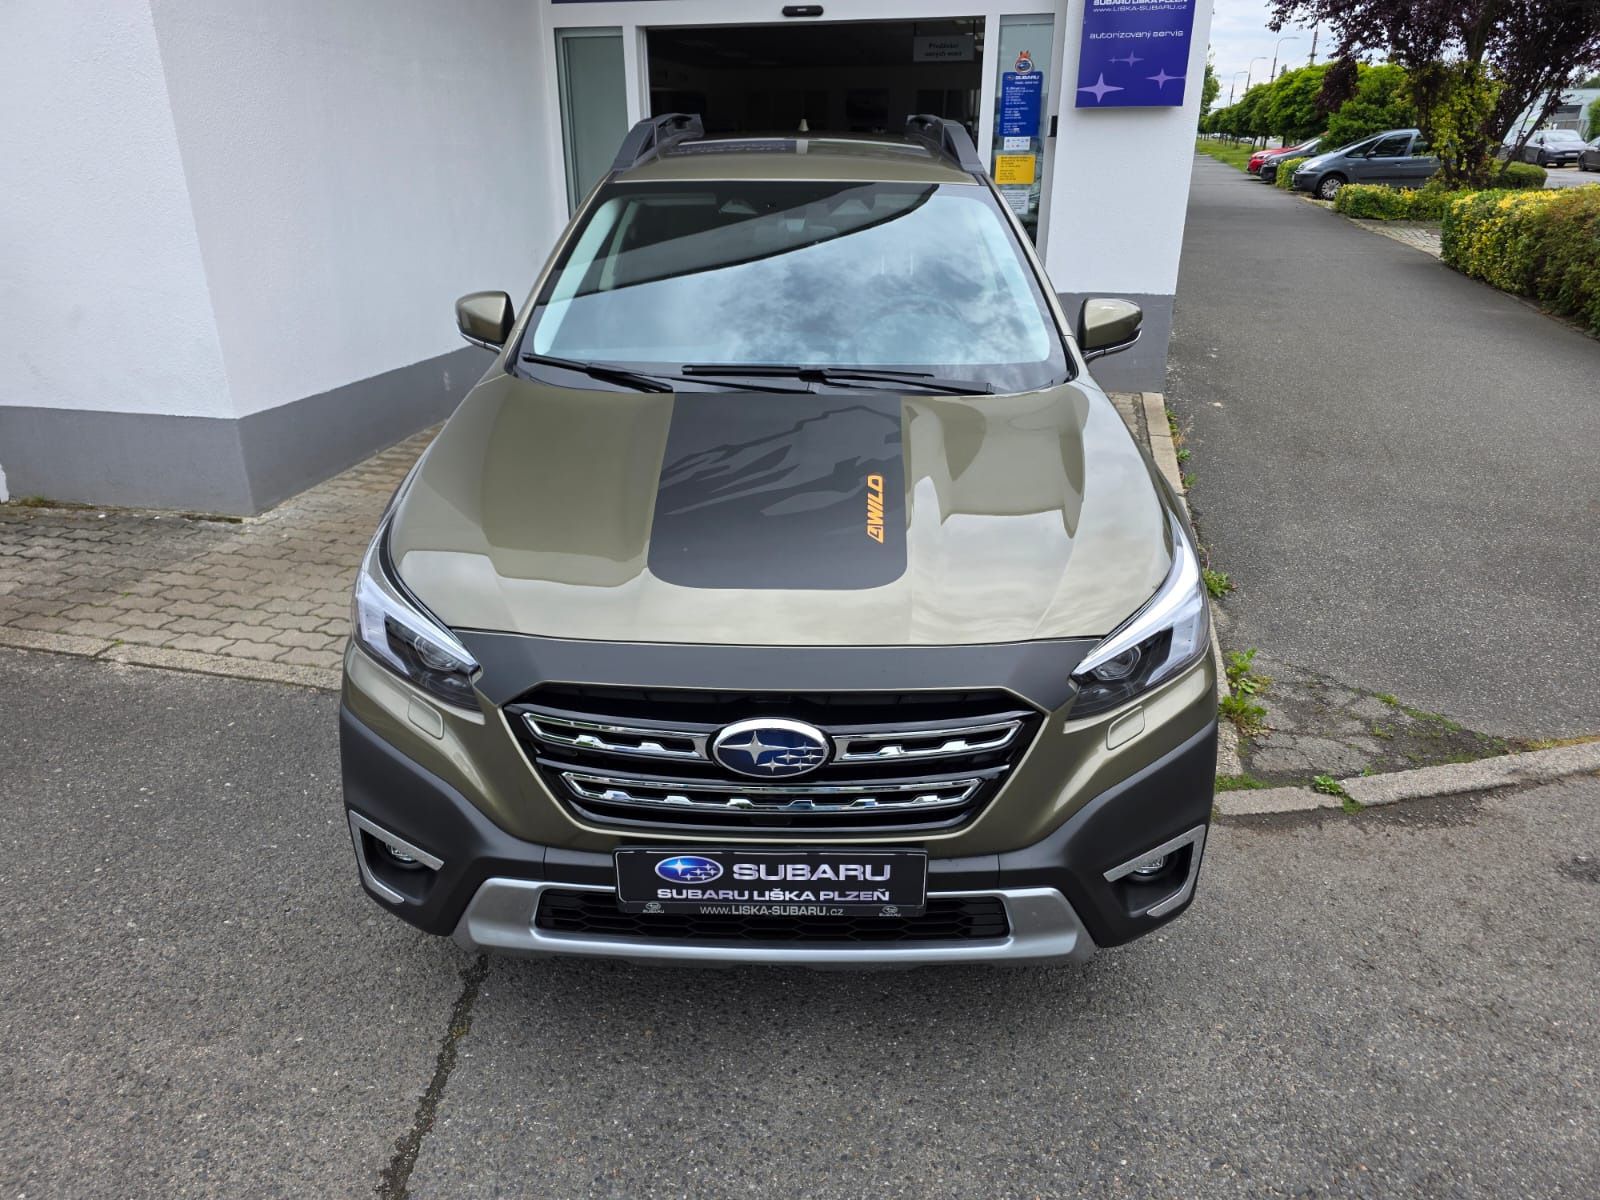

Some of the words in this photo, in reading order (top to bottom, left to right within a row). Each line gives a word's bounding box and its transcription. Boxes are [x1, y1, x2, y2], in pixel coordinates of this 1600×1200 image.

[1090, 31, 1152, 39] autorizovaný
[733, 863, 891, 881] SUBARU
[657, 888, 749, 900] SUBARU
[753, 888, 816, 901] LIŠKA
[819, 888, 890, 901] PLZEŇ
[700, 905, 844, 916] www.LISKA-SUBARU.cz
